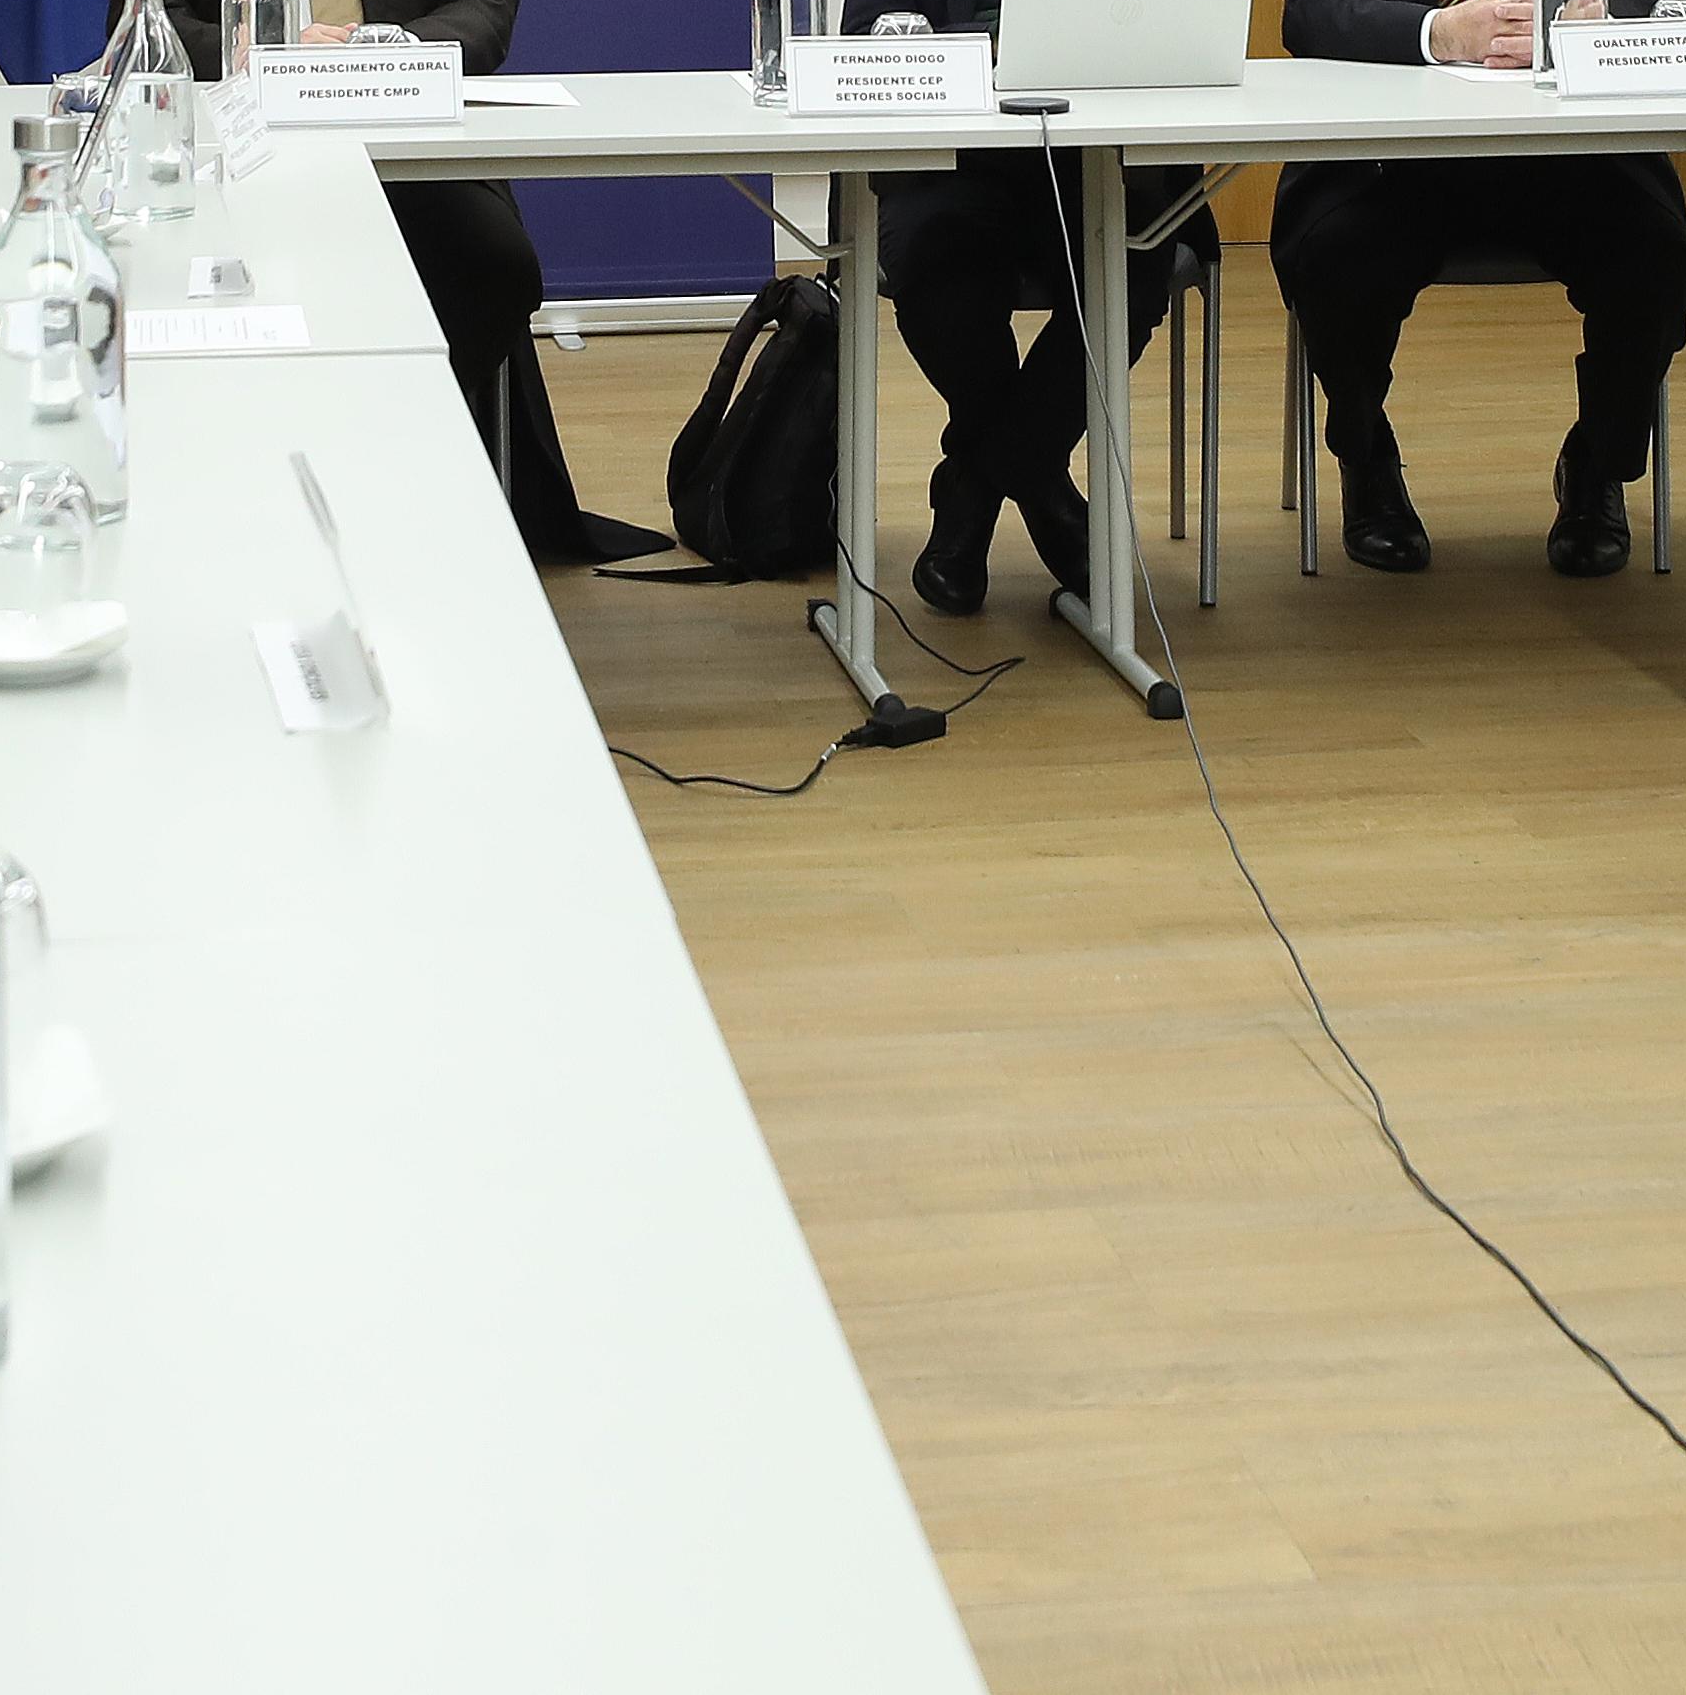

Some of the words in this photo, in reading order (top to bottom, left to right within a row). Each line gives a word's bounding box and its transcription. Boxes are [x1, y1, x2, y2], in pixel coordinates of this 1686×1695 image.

[1593, 37, 1648, 49] GUALTER
[833, 54, 901, 65] FERNANDO
[905, 54, 946, 64] DIOGO
[1598, 55, 1672, 67] PRESIDENTE
[262, 64, 306, 75] PEDRO
[310, 62, 396, 74] NASCIMENTO
[399, 61, 451, 72] CABRAL
[837, 76, 915, 86] PRESIDENTE
[919, 76, 944, 85] CEP
[299, 87, 380, 99] PRESIDENTE
[384, 87, 420, 97] CMPD
[835, 92, 893, 102] SETORES
[896, 91, 947, 101] SOCIAIS
